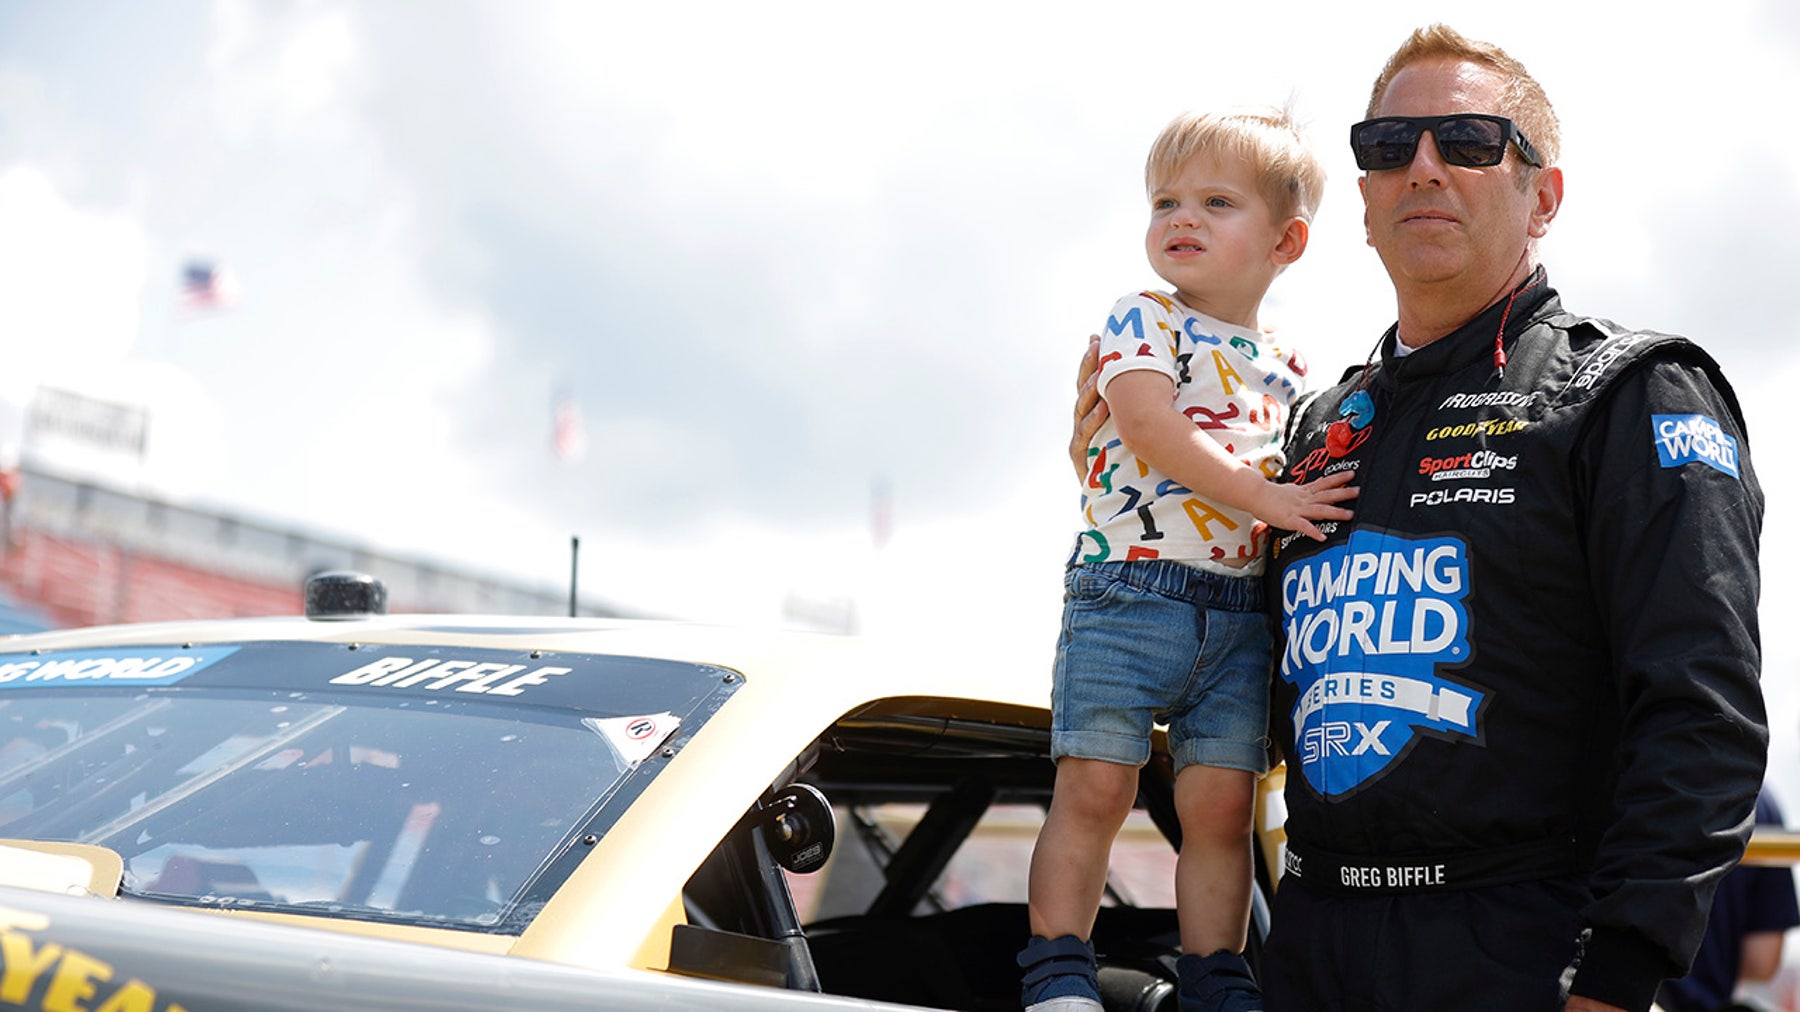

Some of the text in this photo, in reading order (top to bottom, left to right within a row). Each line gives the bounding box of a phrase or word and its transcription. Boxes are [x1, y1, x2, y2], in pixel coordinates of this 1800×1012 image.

[1574, 332, 1651, 390] sparco
[1661, 434, 1738, 475] WORL
[1410, 488, 1516, 508] POLARIS
[1282, 545, 1462, 617] CAMPING
[1281, 598, 1459, 675] WORLD
[25, 657, 196, 681] WORLD
[329, 656, 574, 697] BIFFLE
[1302, 720, 1392, 764] SRX
[1340, 864, 1446, 888] GREG BIFFLE
[0, 930, 193, 1012] YEA
